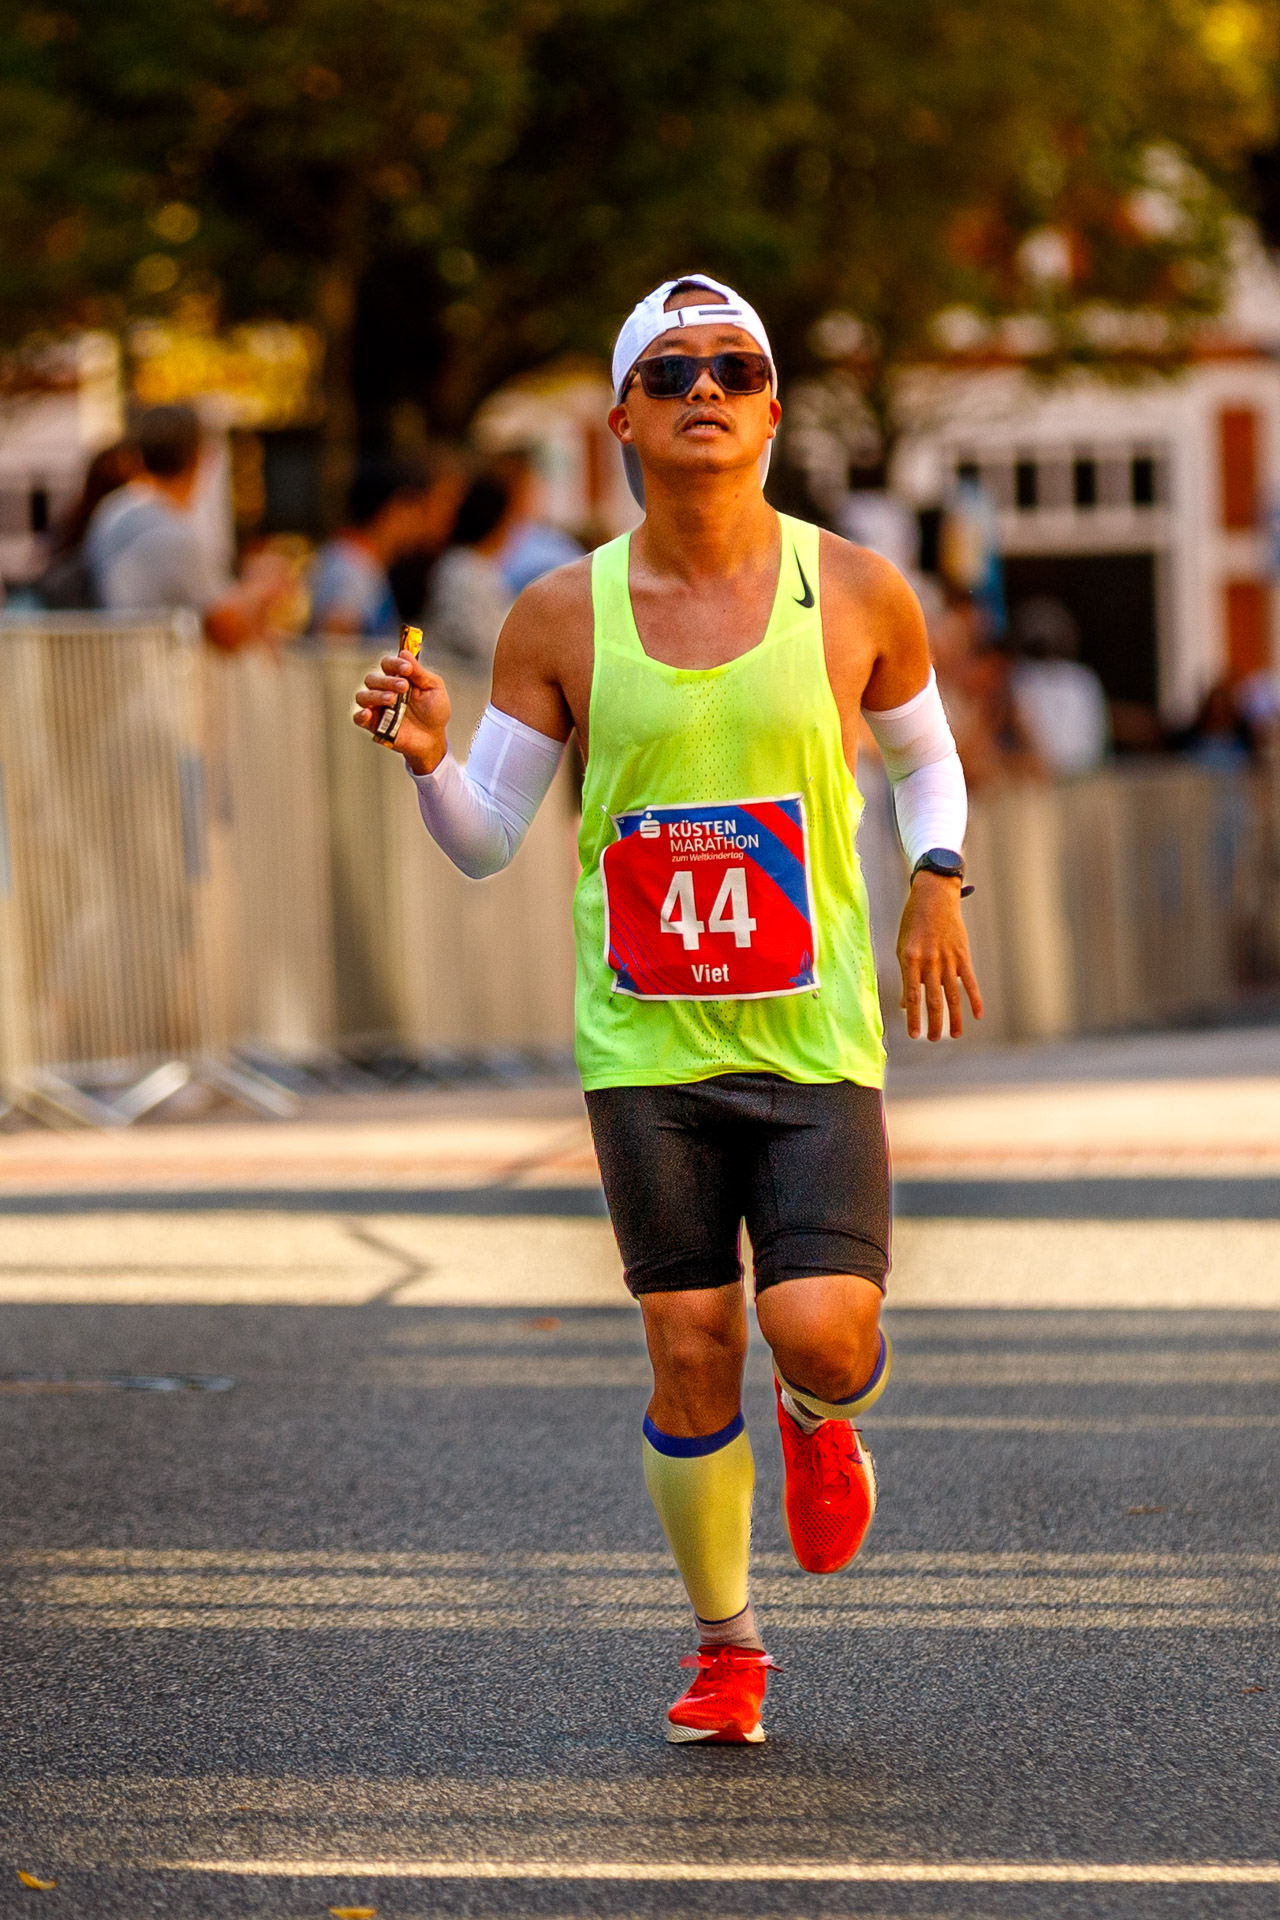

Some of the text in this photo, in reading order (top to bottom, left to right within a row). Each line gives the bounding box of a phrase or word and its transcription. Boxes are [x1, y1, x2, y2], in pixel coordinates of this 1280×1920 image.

[668, 820, 737, 838] KÜSTEN
[670, 834, 760, 853] MARATHON
[671, 851, 744, 863] zum Weltkindertag
[660, 867, 757, 951] 44
[691, 964, 730, 983] Viet
